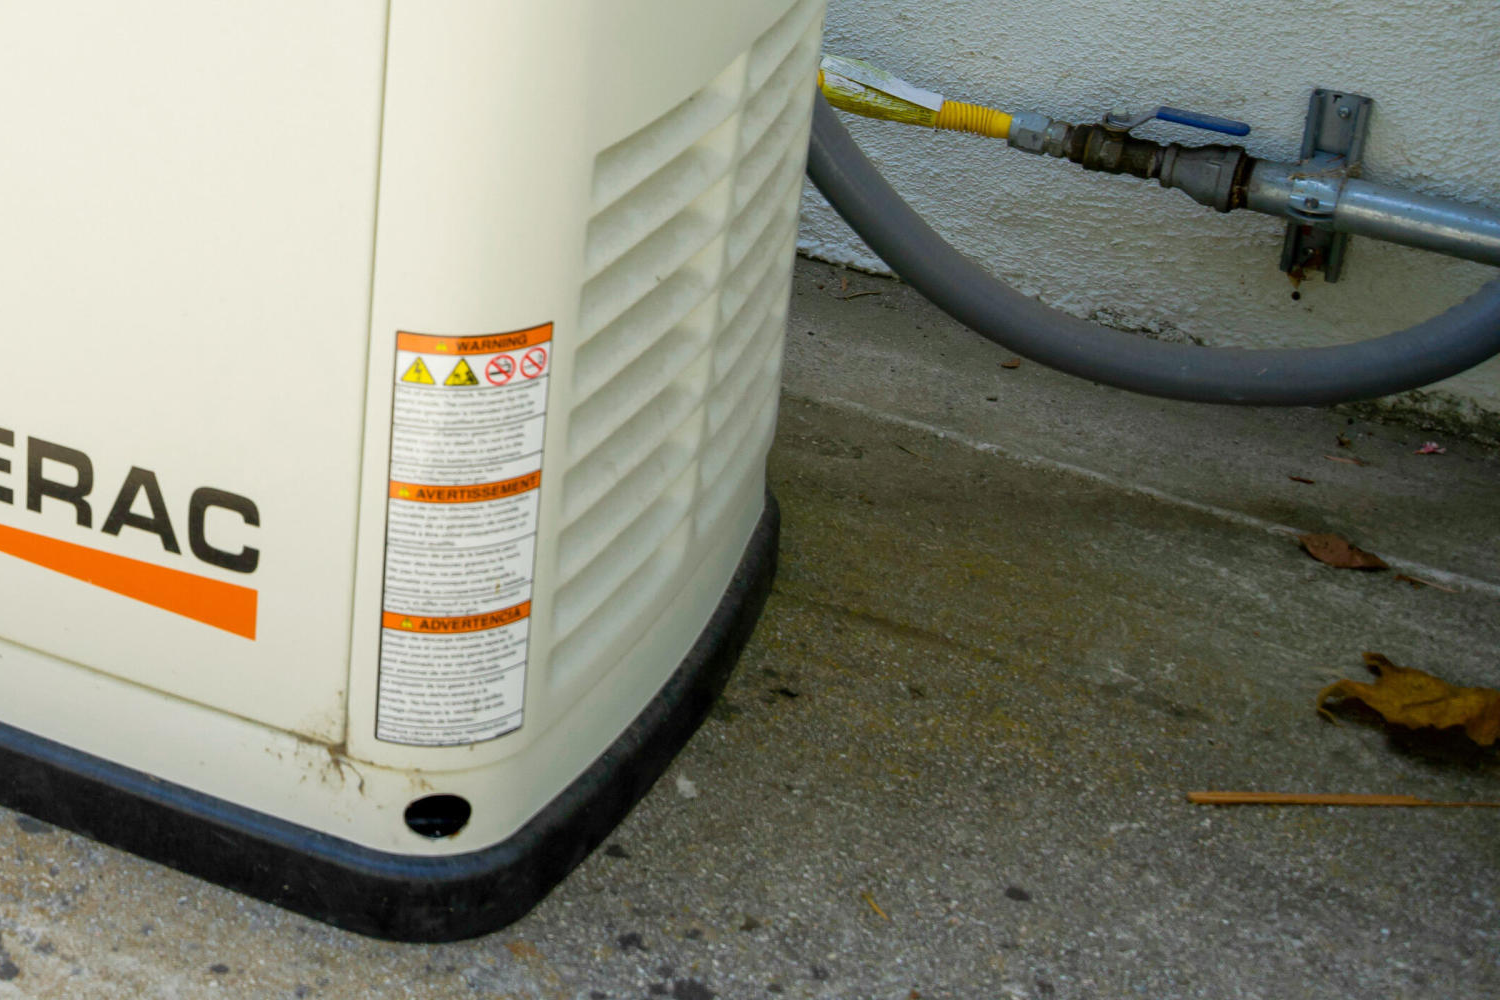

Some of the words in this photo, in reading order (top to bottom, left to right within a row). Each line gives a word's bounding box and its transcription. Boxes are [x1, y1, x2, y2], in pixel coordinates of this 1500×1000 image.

[456, 334, 528, 352] WARNING
[415, 475, 538, 500] AVERTISSEMENT
[419, 608, 522, 630] ADVERTENCIA
